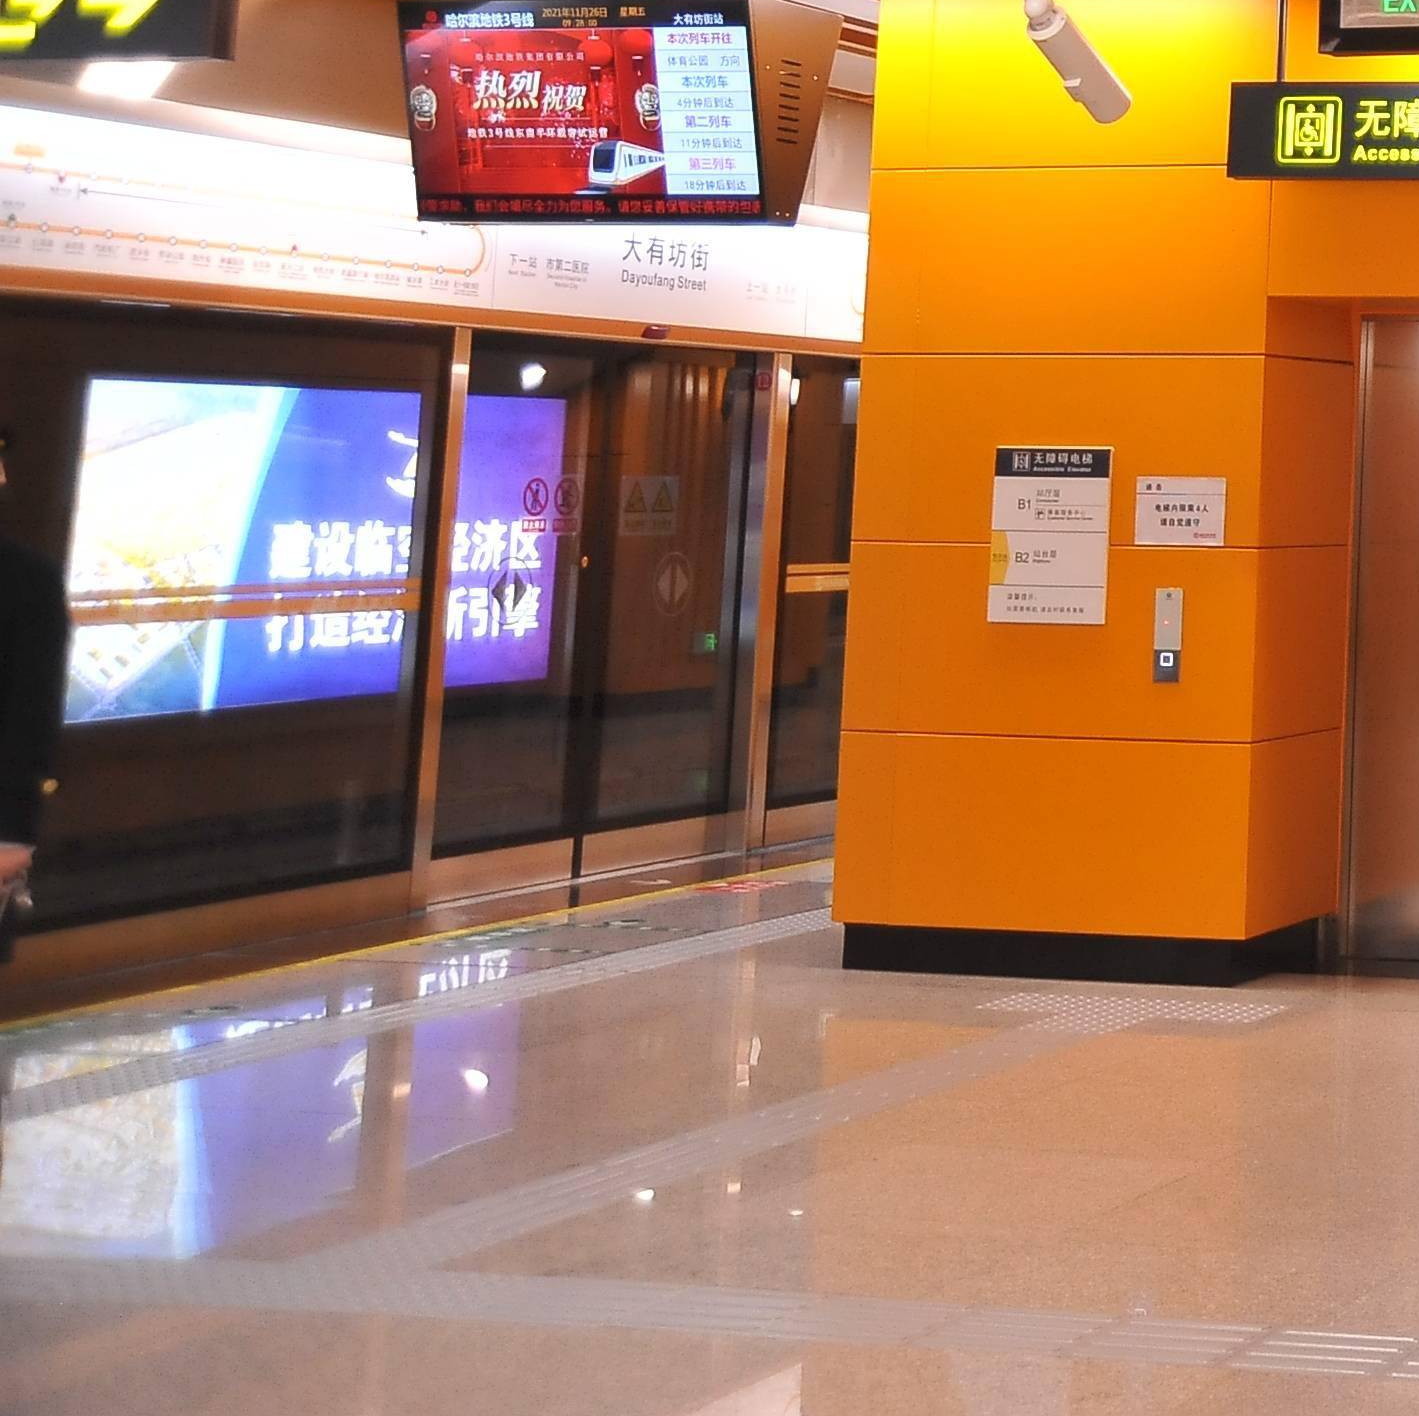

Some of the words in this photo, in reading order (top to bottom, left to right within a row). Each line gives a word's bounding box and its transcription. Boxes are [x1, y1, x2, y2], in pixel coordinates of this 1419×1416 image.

[673, 13, 724, 25] 大有坊街站
[667, 32, 733, 45] 本次列车开往
[667, 55, 709, 67] 体育公园
[720, 55, 741, 67] 方向
[681, 76, 729, 89] 本次列车
[677, 97, 735, 109] 4分钟后到达
[684, 115, 732, 128] 第二列车
[681, 137, 743, 149] 11分钟后到达
[688, 157, 736, 170] 第三列车
[684, 179, 746, 192] 18分钟后到达
[622, 232, 710, 272] 大有坊街
[621, 269, 676, 291] Dayoufang
[677, 274, 707, 293] Street
[1033, 452, 1093, 465] 无障碍电梯
[1017, 498, 1031, 510] B1
[1015, 552, 1029, 563] B2
